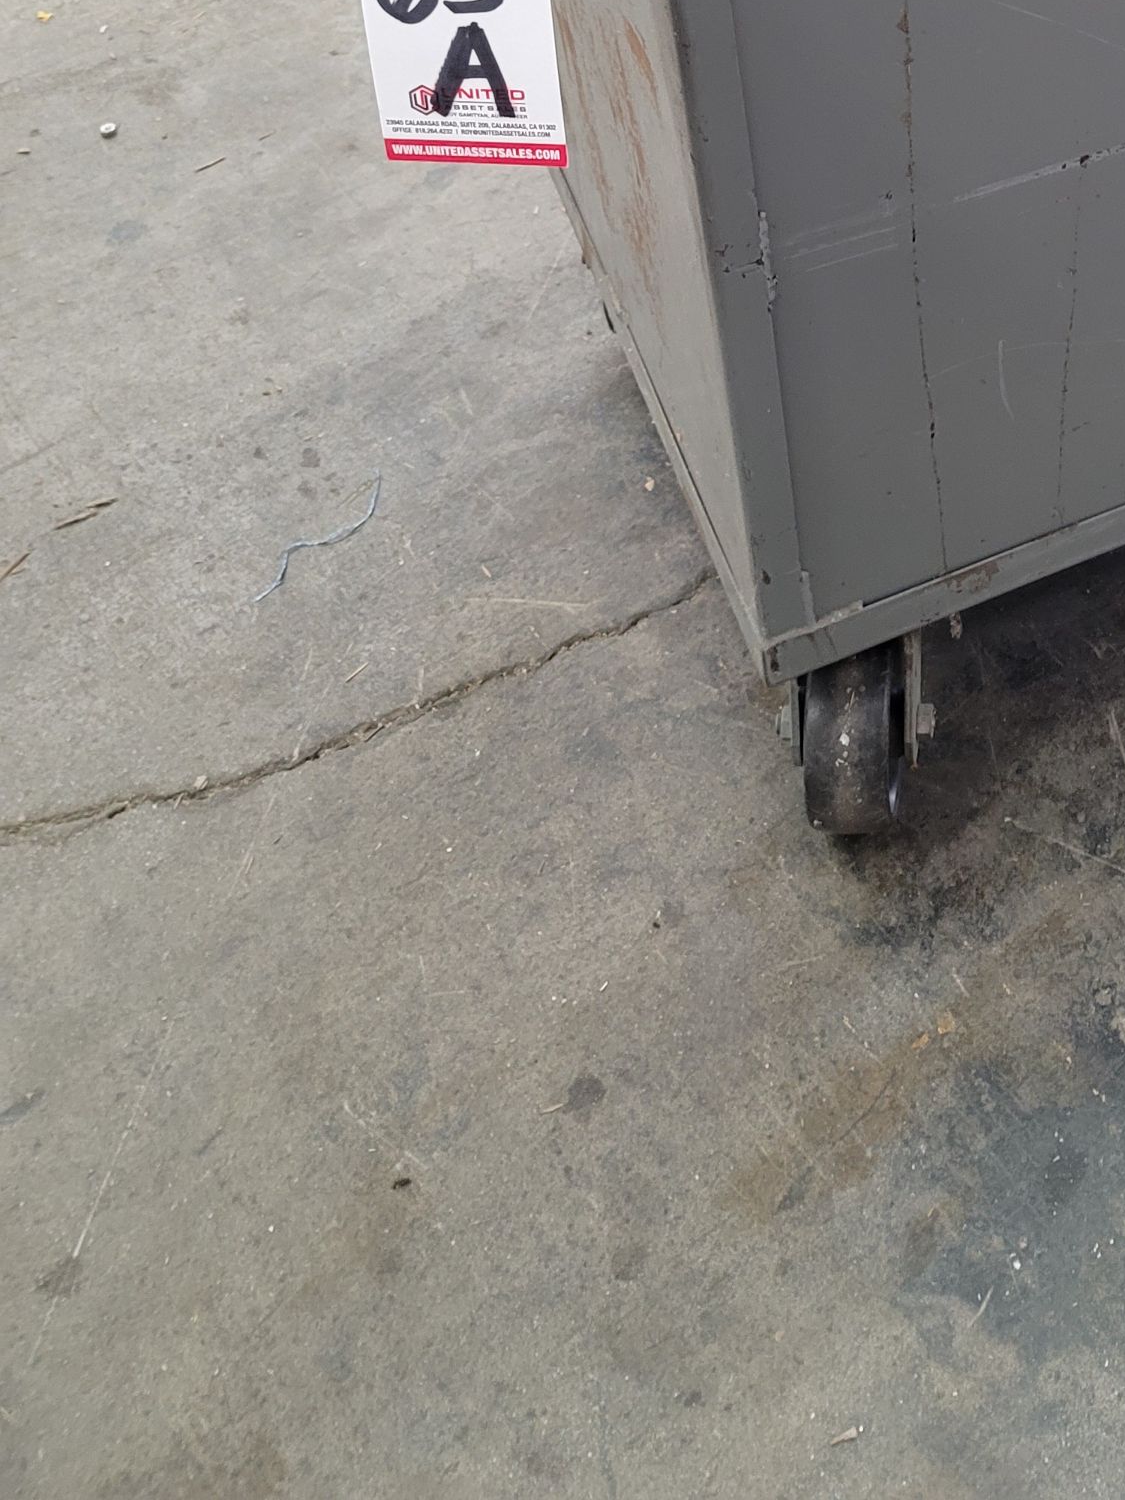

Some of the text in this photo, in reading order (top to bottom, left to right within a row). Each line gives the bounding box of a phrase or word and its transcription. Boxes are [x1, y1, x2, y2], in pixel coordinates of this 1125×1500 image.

[430, 21, 516, 118] A
[461, 128, 551, 137] ROY@UNITEDASSETSALES.COM
[391, 143, 560, 160] WWW.UNITEDASSETSALES.COM
